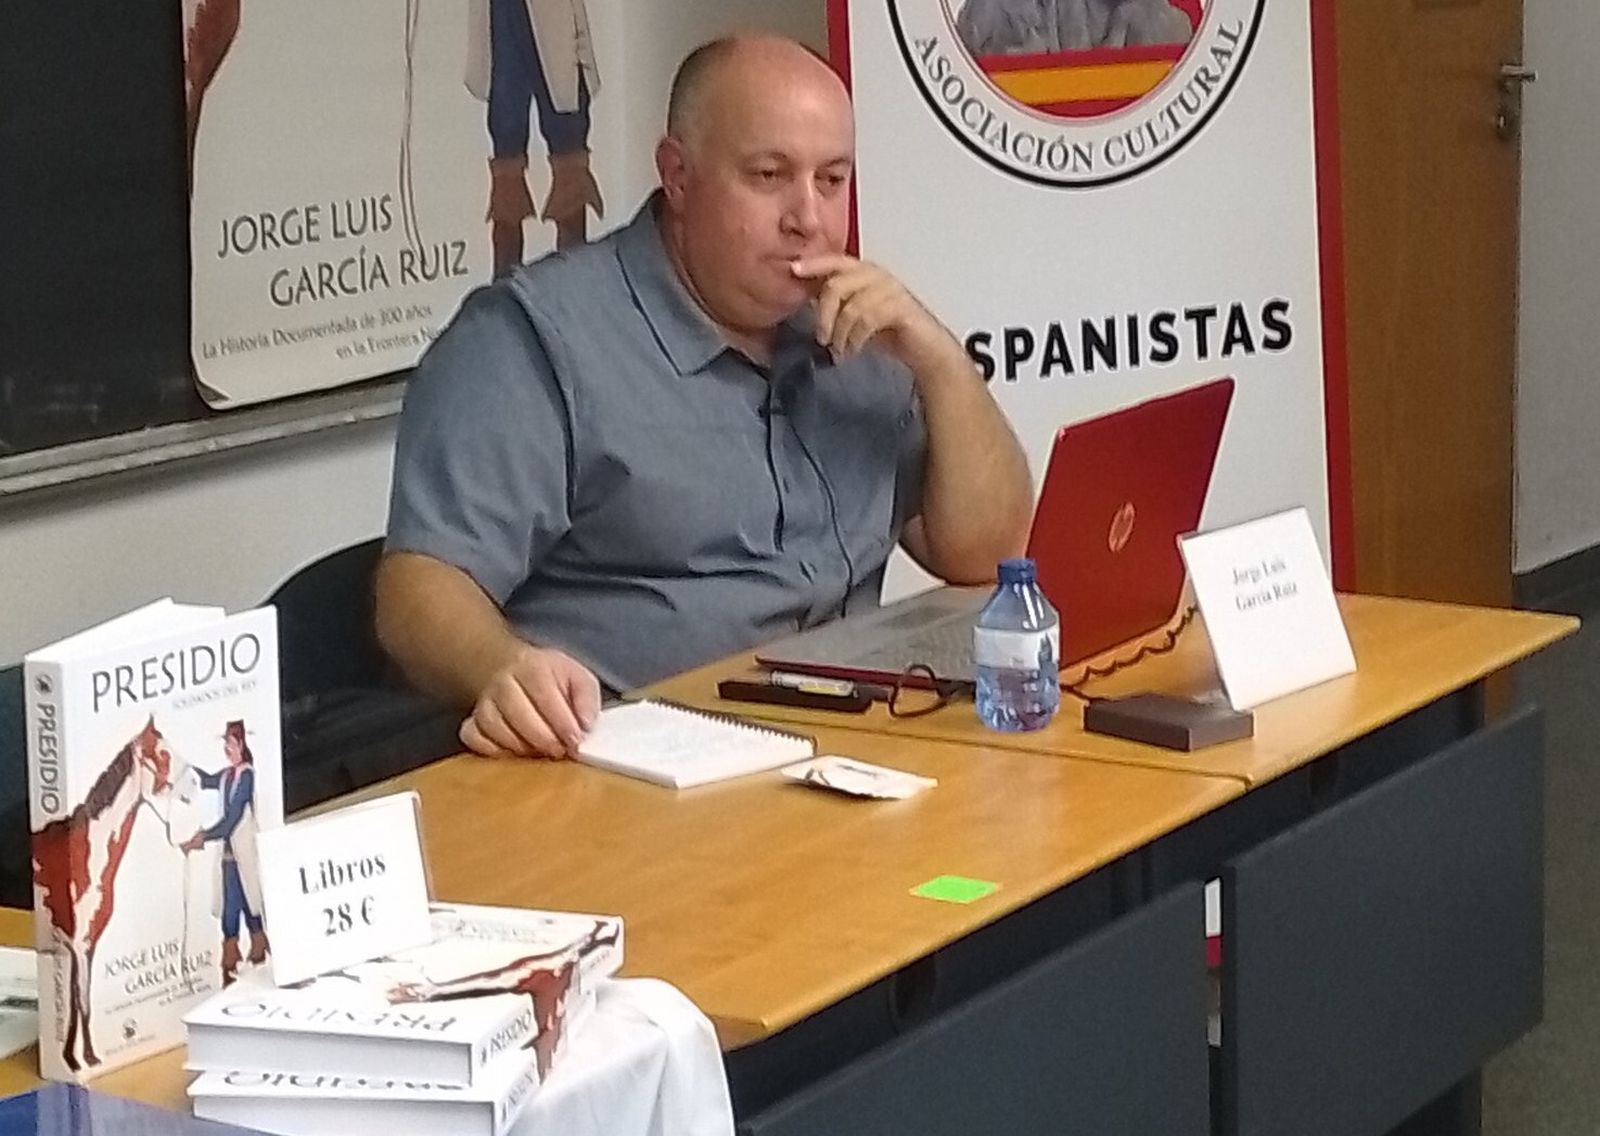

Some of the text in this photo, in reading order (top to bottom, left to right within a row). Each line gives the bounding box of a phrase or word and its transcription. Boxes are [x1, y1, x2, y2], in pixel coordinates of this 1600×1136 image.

[913, 17, 1244, 173] ASOCIACIÓN CULTURAL
[217, 194, 392, 259] JORGE LUIS
[270, 240, 469, 307] GARCÍA RUIZ
[202, 342, 217, 359] La
[219, 334, 270, 353] Historia
[272, 316, 358, 347] Documentada
[360, 313, 375, 330] de
[336, 346, 353, 360] en
[355, 341, 367, 357] la
[367, 332, 420, 353] Frontera
[92, 633, 260, 713] PRESIDIO
[37, 703, 60, 815] PRESIDIO
[298, 853, 386, 896] Libros
[322, 895, 376, 937] 28 €
